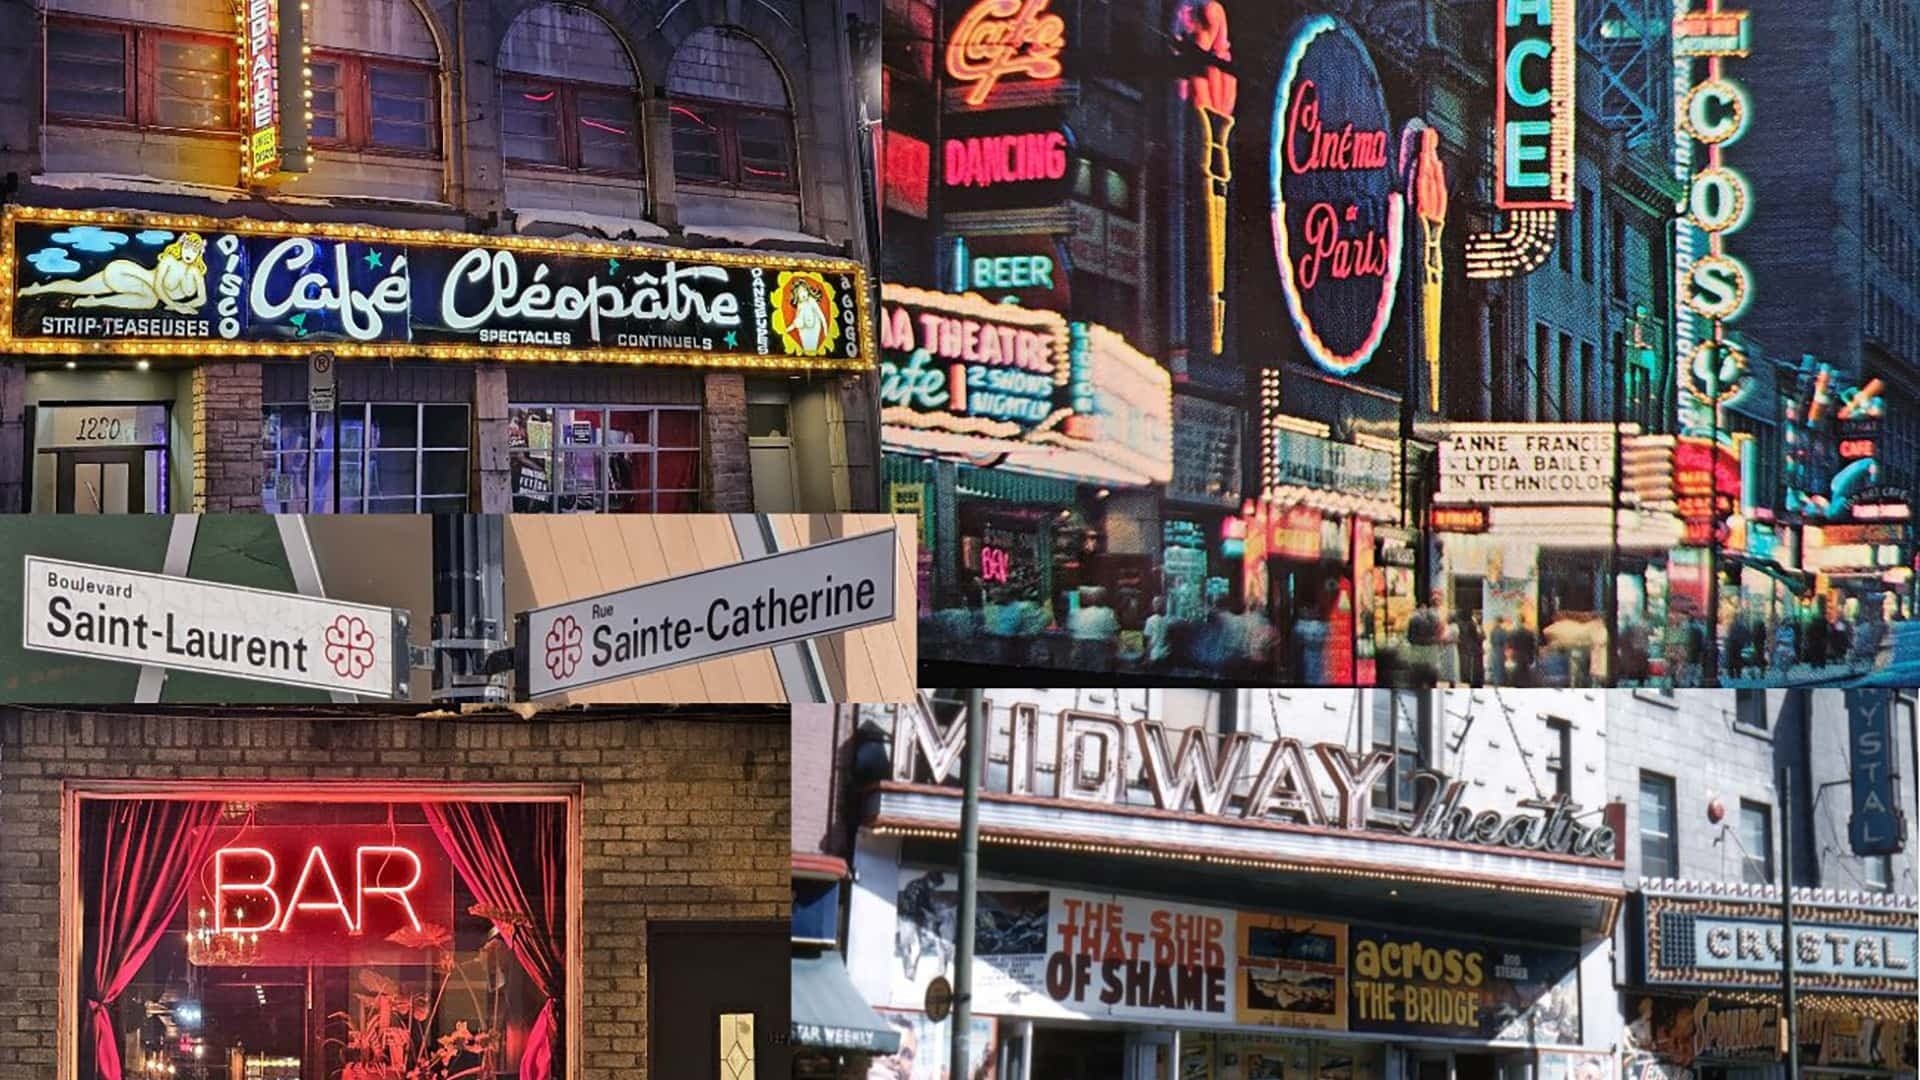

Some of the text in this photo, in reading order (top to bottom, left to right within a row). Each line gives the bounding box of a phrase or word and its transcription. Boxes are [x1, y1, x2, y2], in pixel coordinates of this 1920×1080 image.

[946, 0, 1066, 105] Cafe
[945, 131, 1068, 187] DANCING
[1300, 202, 1390, 290] Paris
[216, 234, 241, 340] DISCO
[250, 237, 408, 341] Café
[441, 247, 742, 342] Cléopâtre
[973, 255, 1054, 289] BEER
[41, 316, 209, 337] STRIP-TEASEUSES
[479, 328, 713, 351] SPECTACLES CONTINUELS
[920, 312, 1054, 374] THEATRE
[967, 366, 1054, 397] 2 SHOWS
[967, 393, 1052, 424] NIGHTLY
[1454, 435, 1612, 452] ANNE FRANCIS
[1465, 455, 1521, 473] LYDIA
[1534, 455, 1602, 472] BAILEY
[1476, 474, 1613, 491] TECHNICOLOR
[47, 572, 133, 599] Boulevard
[46, 595, 309, 673] Saint-Laurent
[591, 575, 876, 669] Sainte-Catherine
[592, 603, 615, 620] Rue
[892, 688, 1617, 860] MIDWAY Theatre
[213, 845, 423, 933] BAR
[1063, 899, 1224, 940] THE SHIP
[1057, 924, 1226, 971] THAT DIED
[1354, 940, 1484, 986] across
[1706, 926, 1910, 971] CRYSTAL
[1045, 950, 1093, 1003] OF
[1100, 957, 1227, 1013] SHAME
[1354, 980, 1481, 1028] THE BRIDGE
[824, 1027, 875, 1044] WEEKLY
